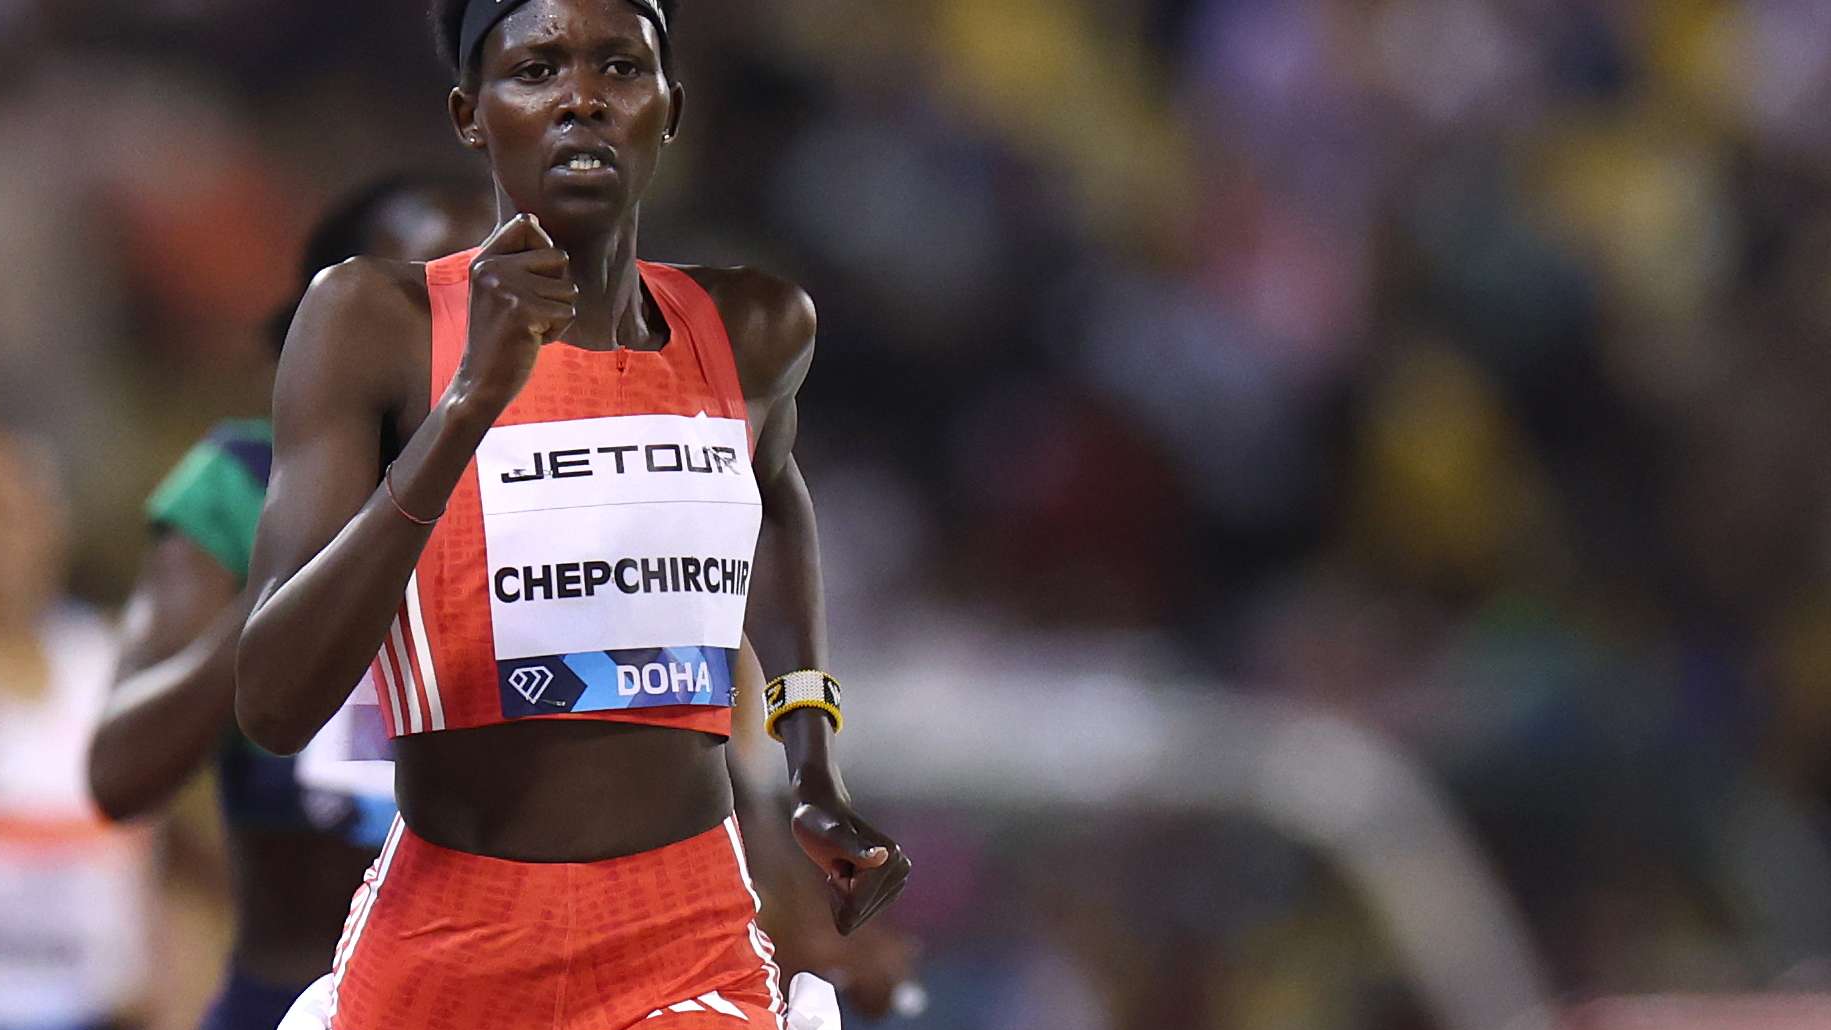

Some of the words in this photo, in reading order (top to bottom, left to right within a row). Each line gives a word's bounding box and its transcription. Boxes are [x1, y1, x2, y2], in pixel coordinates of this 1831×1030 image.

[501, 444, 740, 483] JETOUR
[494, 557, 749, 603] CHEPCHIRCHIR
[617, 661, 712, 696] DOHA
